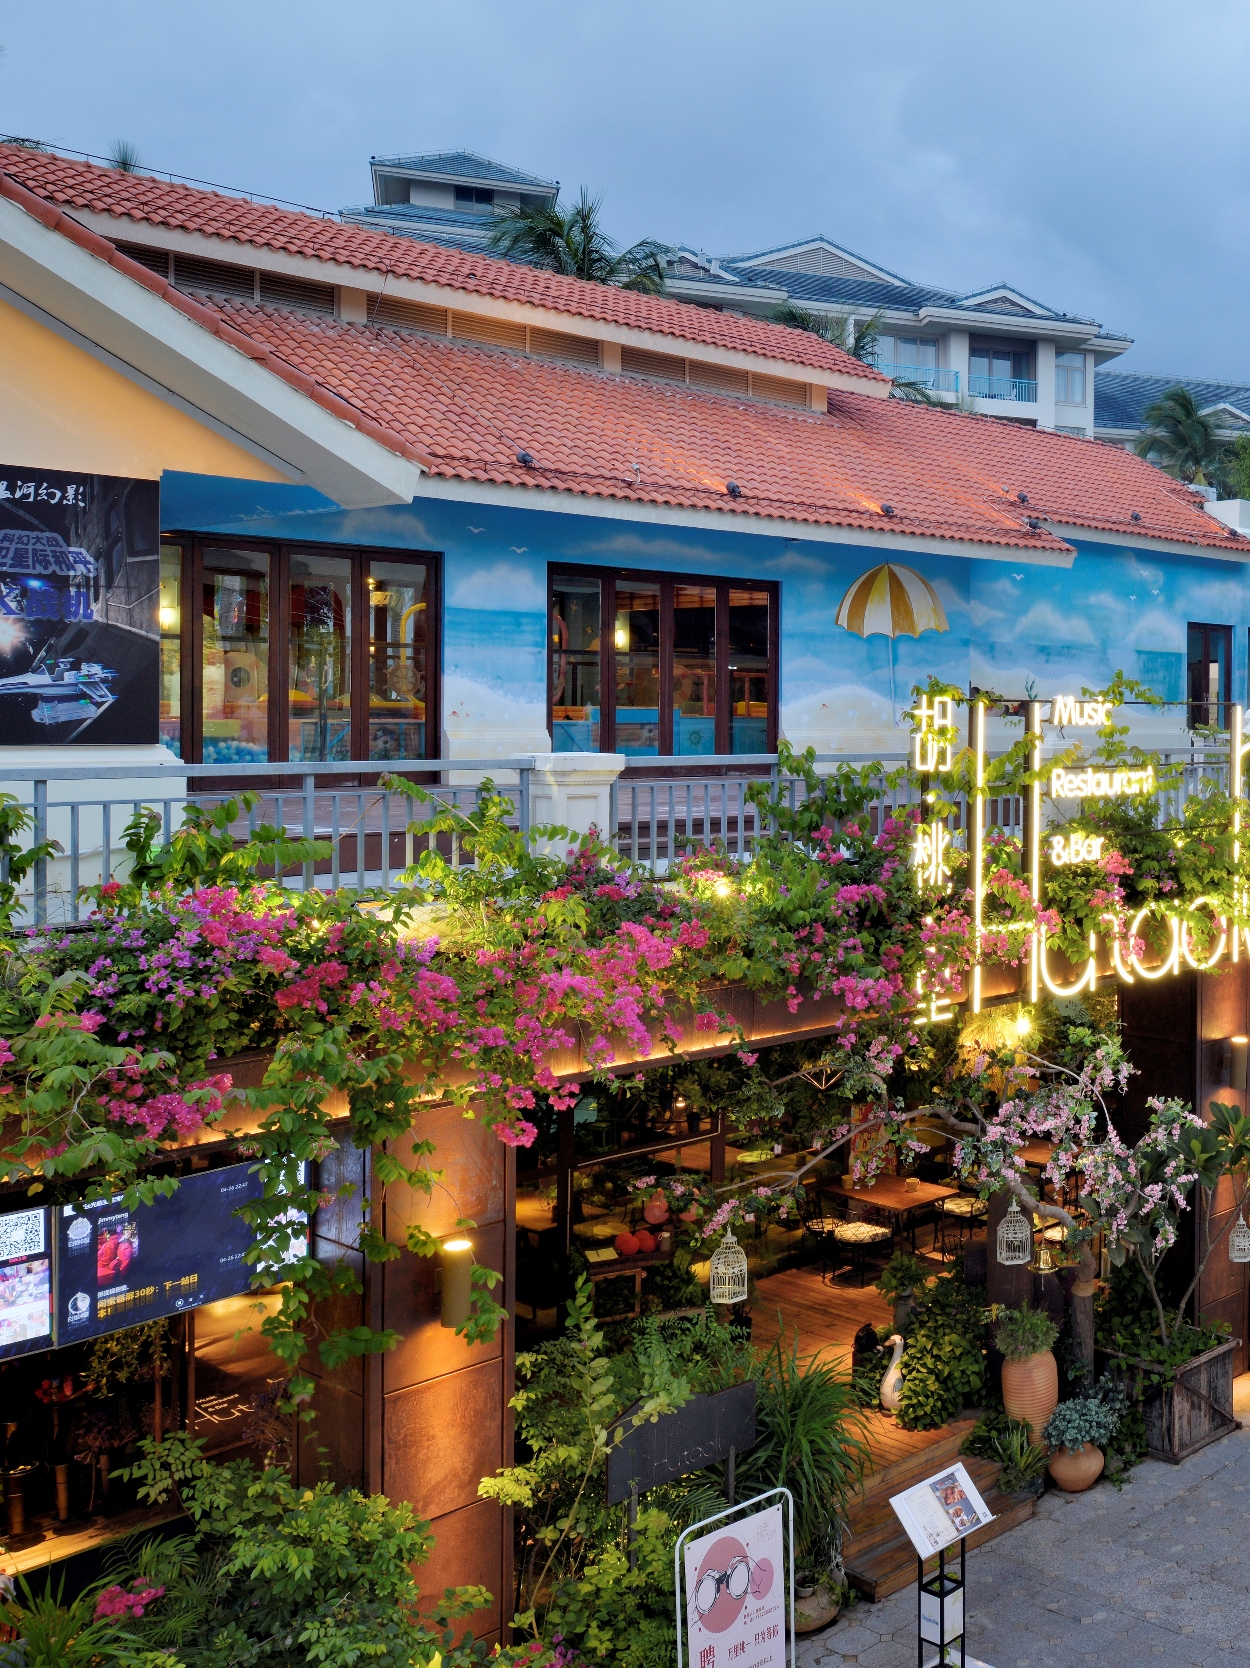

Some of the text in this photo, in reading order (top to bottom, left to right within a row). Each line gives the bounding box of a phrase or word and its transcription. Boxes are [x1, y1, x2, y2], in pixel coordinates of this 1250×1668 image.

[1, 532, 63, 549] 科幻大战
[1054, 695, 1113, 726] Music
[1051, 766, 1156, 799] Restaurant
[699, 1644, 716, 1668] 聘
